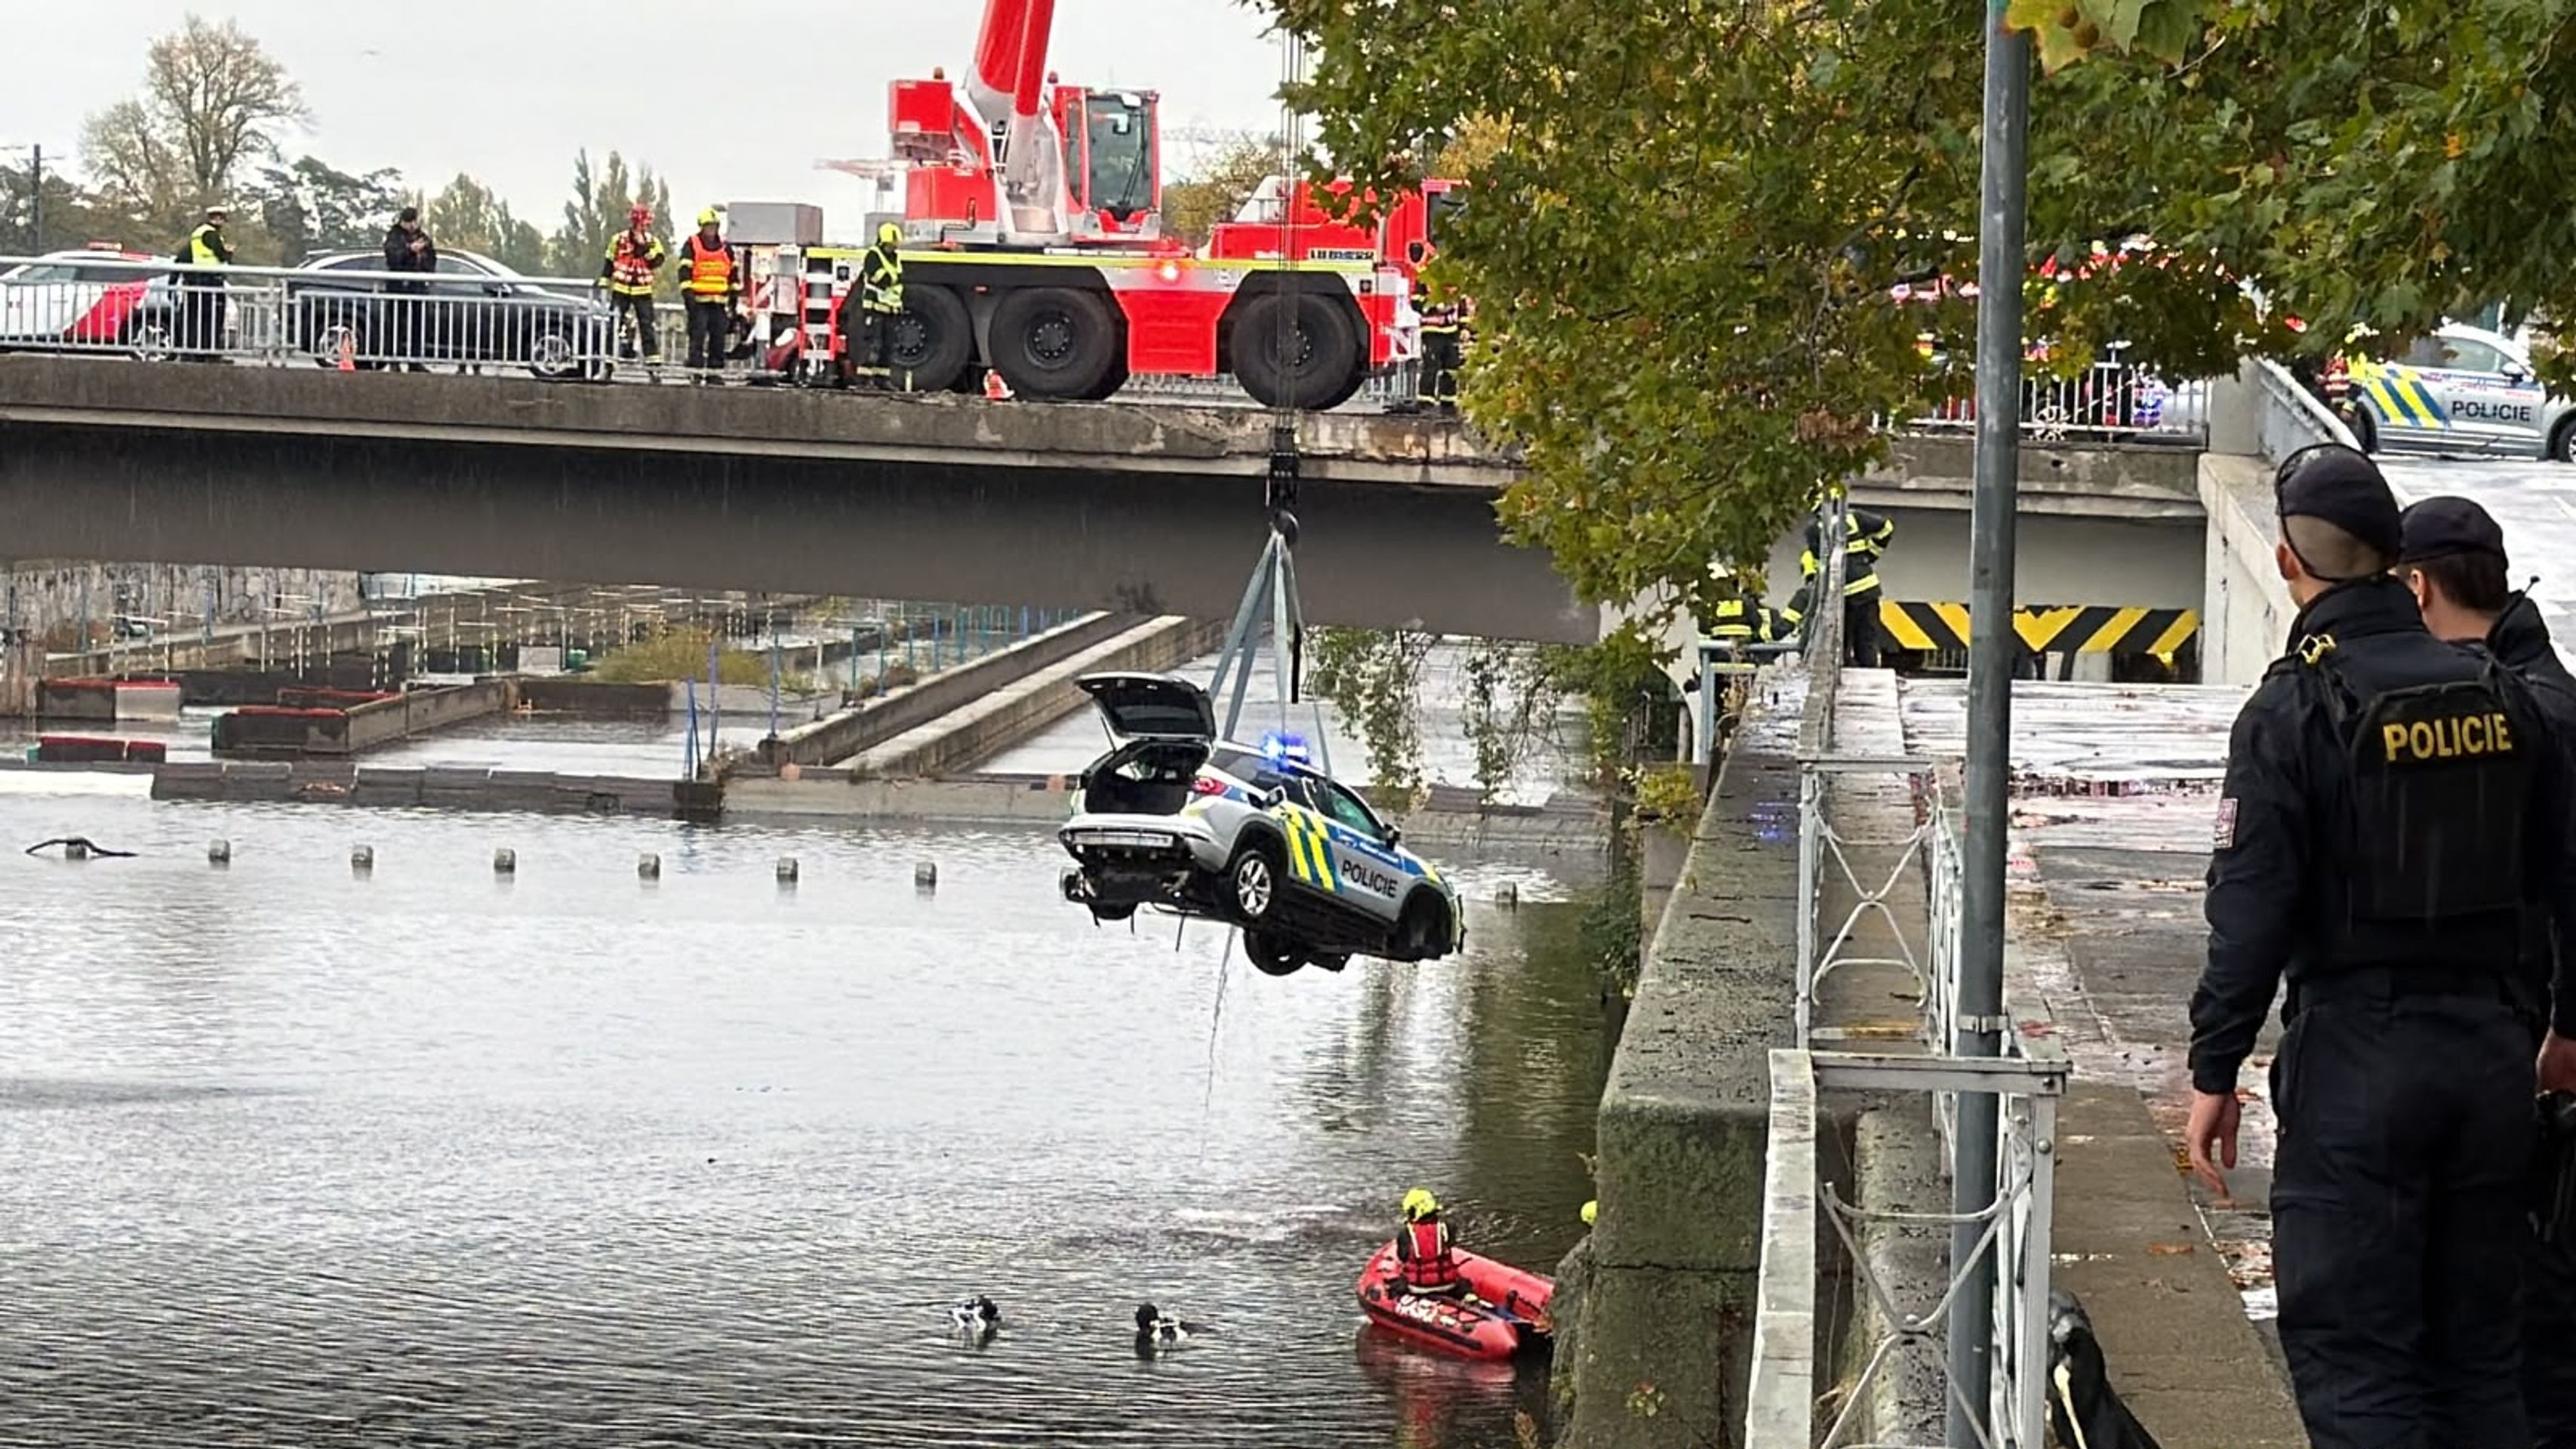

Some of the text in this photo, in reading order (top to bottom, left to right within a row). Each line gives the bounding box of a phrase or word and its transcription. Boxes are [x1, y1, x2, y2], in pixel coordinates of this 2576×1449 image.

[2452, 401, 2531, 421] POLICIE
[2383, 712, 2513, 761] POLICIE
[1341, 860, 1398, 898] POLICIE
